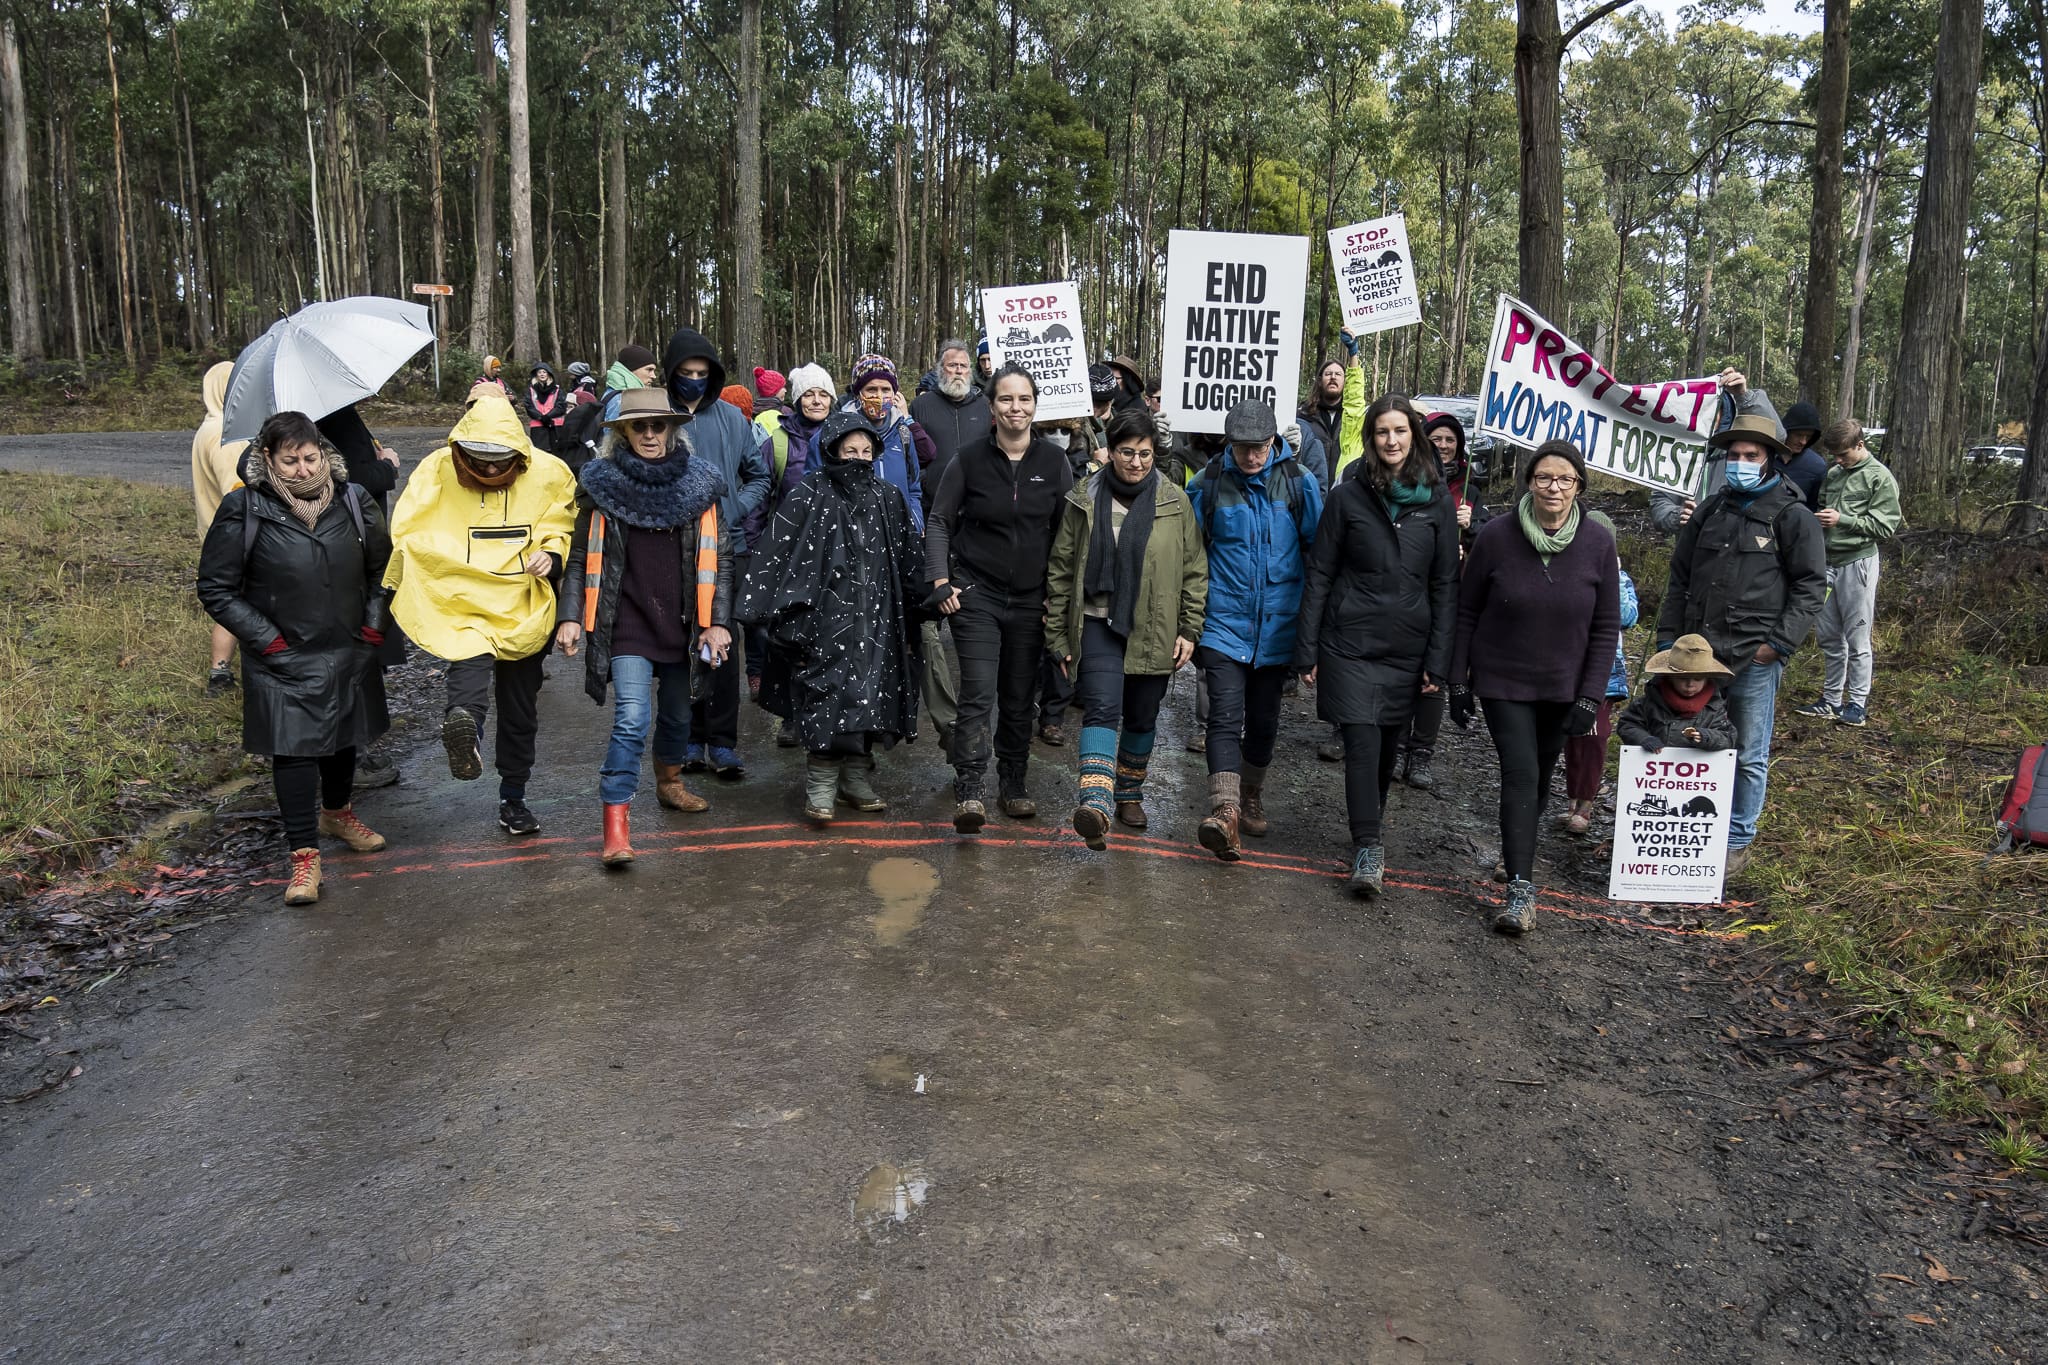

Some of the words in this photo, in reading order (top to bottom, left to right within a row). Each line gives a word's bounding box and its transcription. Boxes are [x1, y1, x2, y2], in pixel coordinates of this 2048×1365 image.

[1347, 228, 1388, 246] STOP
[1205, 262, 1267, 304] END
[1348, 267, 1401, 286] PROTECT
[1349, 276, 1403, 295] WOMBAT
[1356, 286, 1400, 302] FOREST
[1004, 296, 1058, 312] STOP
[1353, 305, 1374, 316] VOTE
[1375, 297, 1413, 312] FORESTS
[1186, 306, 1280, 345] NATIVE
[1004, 346, 1071, 360] PROTECT
[1014, 357, 1072, 370] OMBAT
[1183, 346, 1279, 381] FOREST
[1501, 309, 1717, 432] PROTECT
[1033, 369, 1068, 380] REST
[1484, 371, 1607, 462] WOMBAT
[1607, 420, 1705, 490] FOREST
[1645, 761, 1710, 778] STOP
[1632, 820, 1713, 833] PROTECT
[1631, 833, 1711, 846] WOMBAT
[1637, 846, 1703, 858] FOREST
[1620, 863, 1625, 874] I
[1628, 864, 1658, 875] VOTE
[1661, 864, 1716, 876] FORESTS
